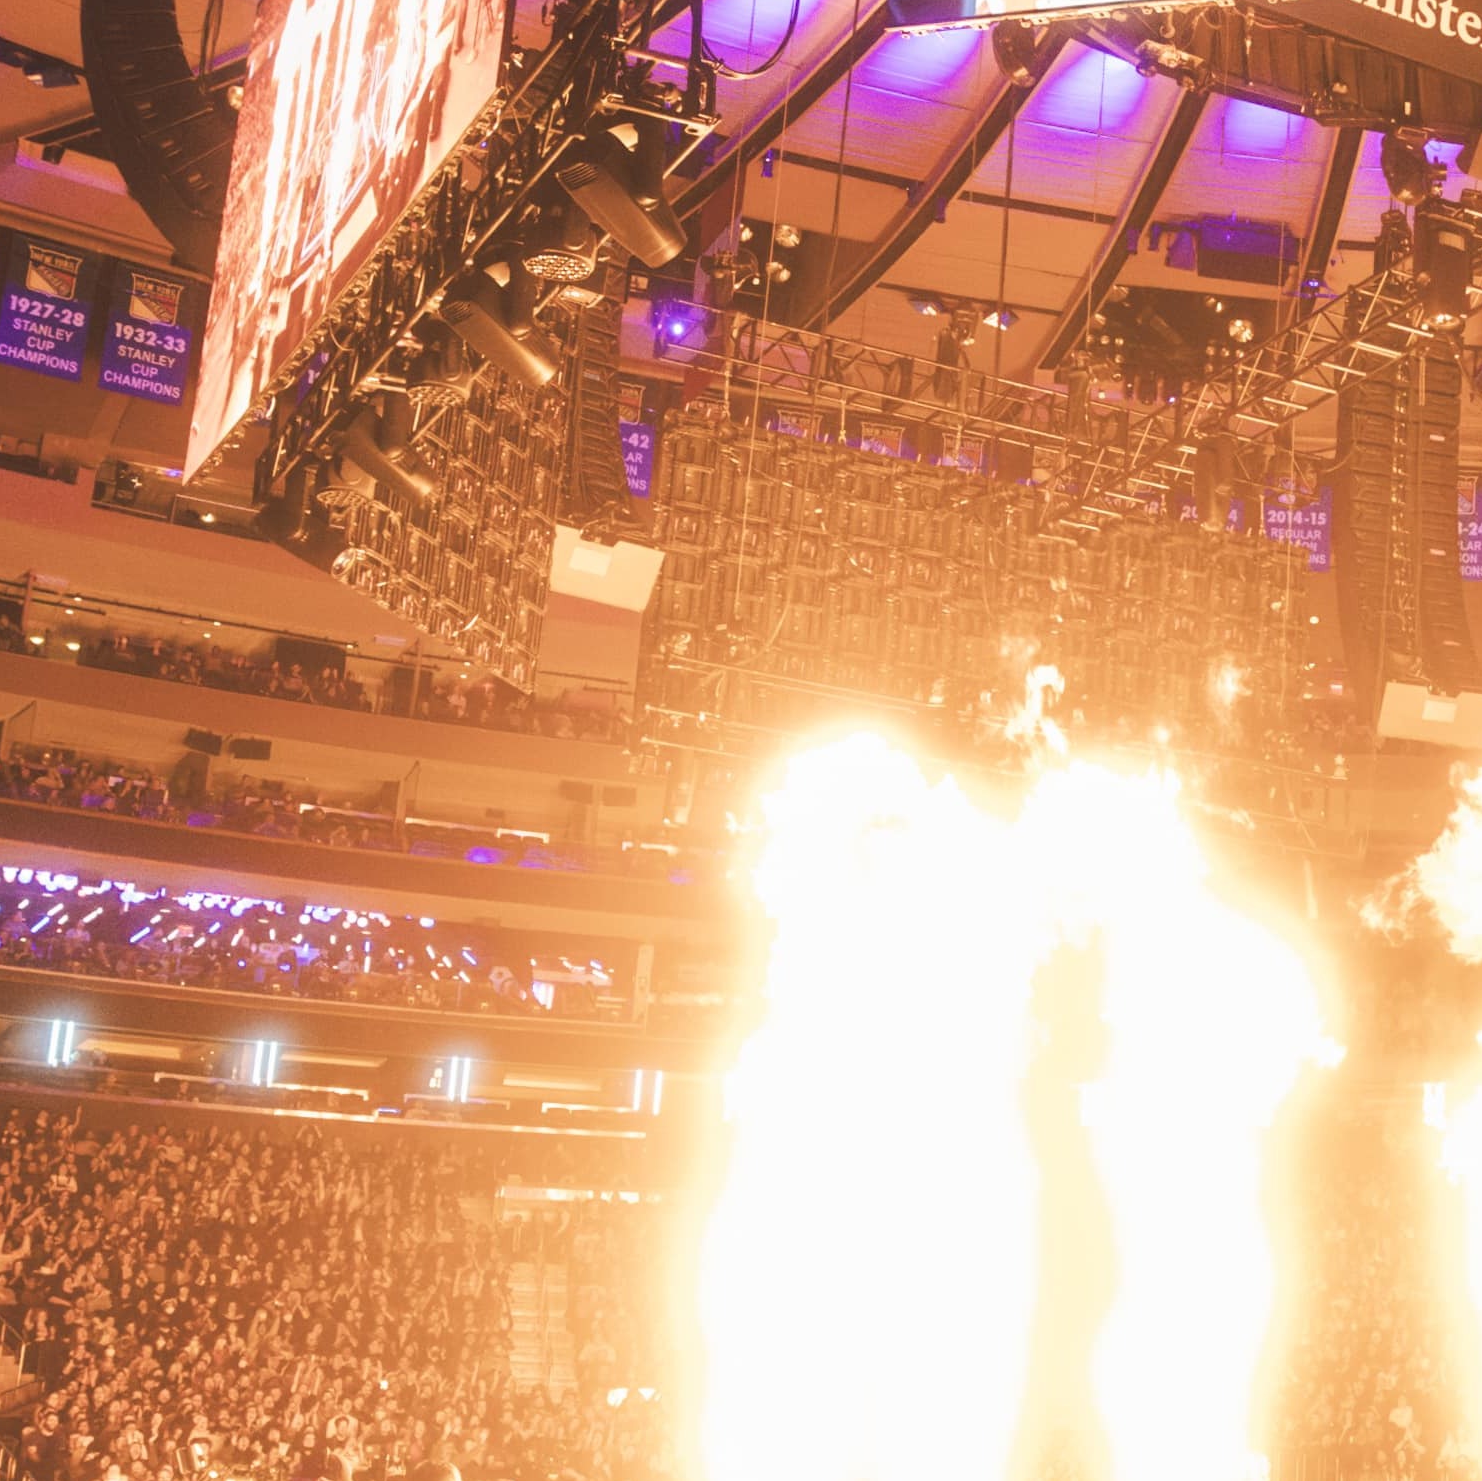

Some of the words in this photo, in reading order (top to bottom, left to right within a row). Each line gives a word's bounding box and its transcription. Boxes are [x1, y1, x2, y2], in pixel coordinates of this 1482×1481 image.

[8, 294, 86, 328] 1927-28
[13, 318, 75, 343] STANLEY
[26, 335, 56, 351] CUP
[113, 321, 188, 353] 1932-33
[117, 344, 177, 369] STANLEY
[130, 362, 159, 378] CUP
[103, 369, 182, 400] CHAMPIONS
